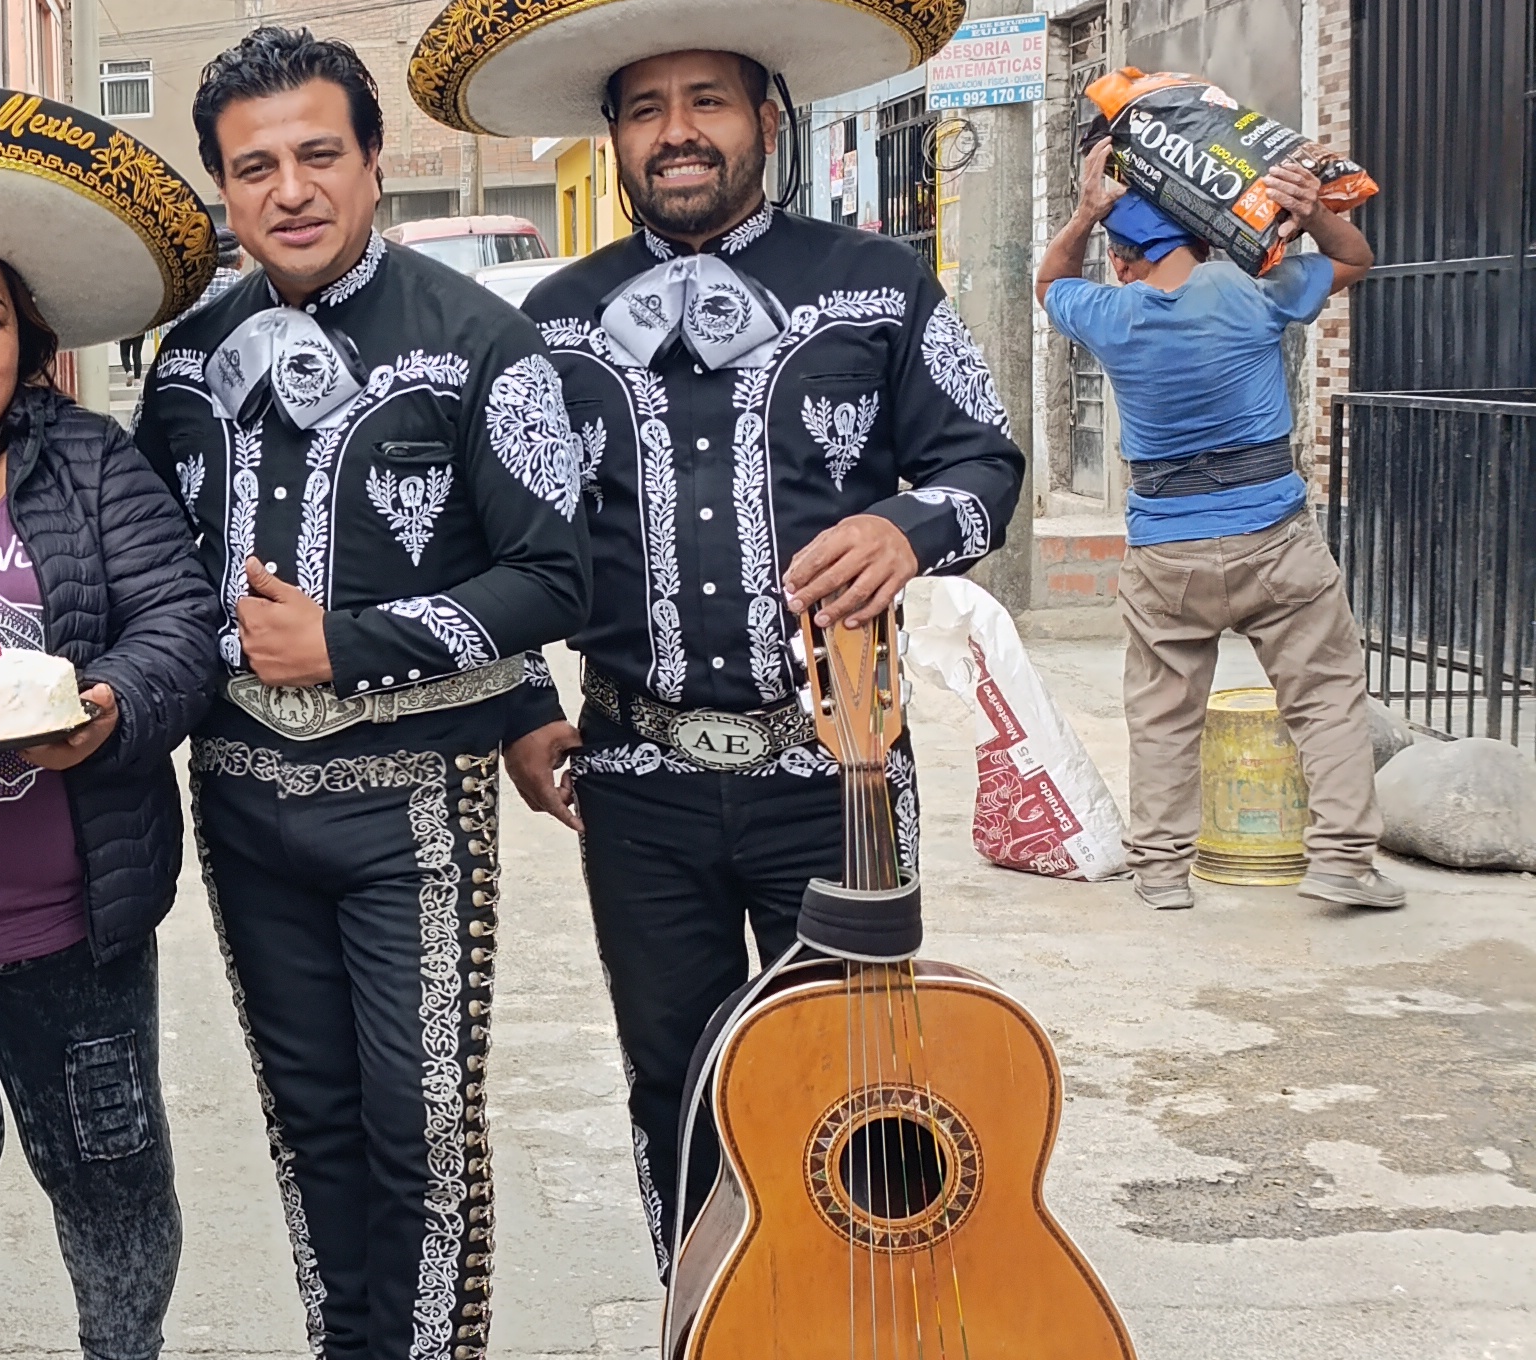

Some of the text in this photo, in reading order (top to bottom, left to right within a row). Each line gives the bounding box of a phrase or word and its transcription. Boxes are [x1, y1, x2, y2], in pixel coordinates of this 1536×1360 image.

[971, 25, 1020, 37] EULER
[994, 16, 1041, 28] ESTUDIOS
[1022, 36, 1043, 52] DE
[930, 84, 1042, 109] Cel.: 992 170 165
[1140, 120, 1243, 200] CANBO
[1208, 143, 1257, 180] Dog Food
[1039, 780, 1074, 831] Extruido
[1076, 835, 1096, 864] 35%
